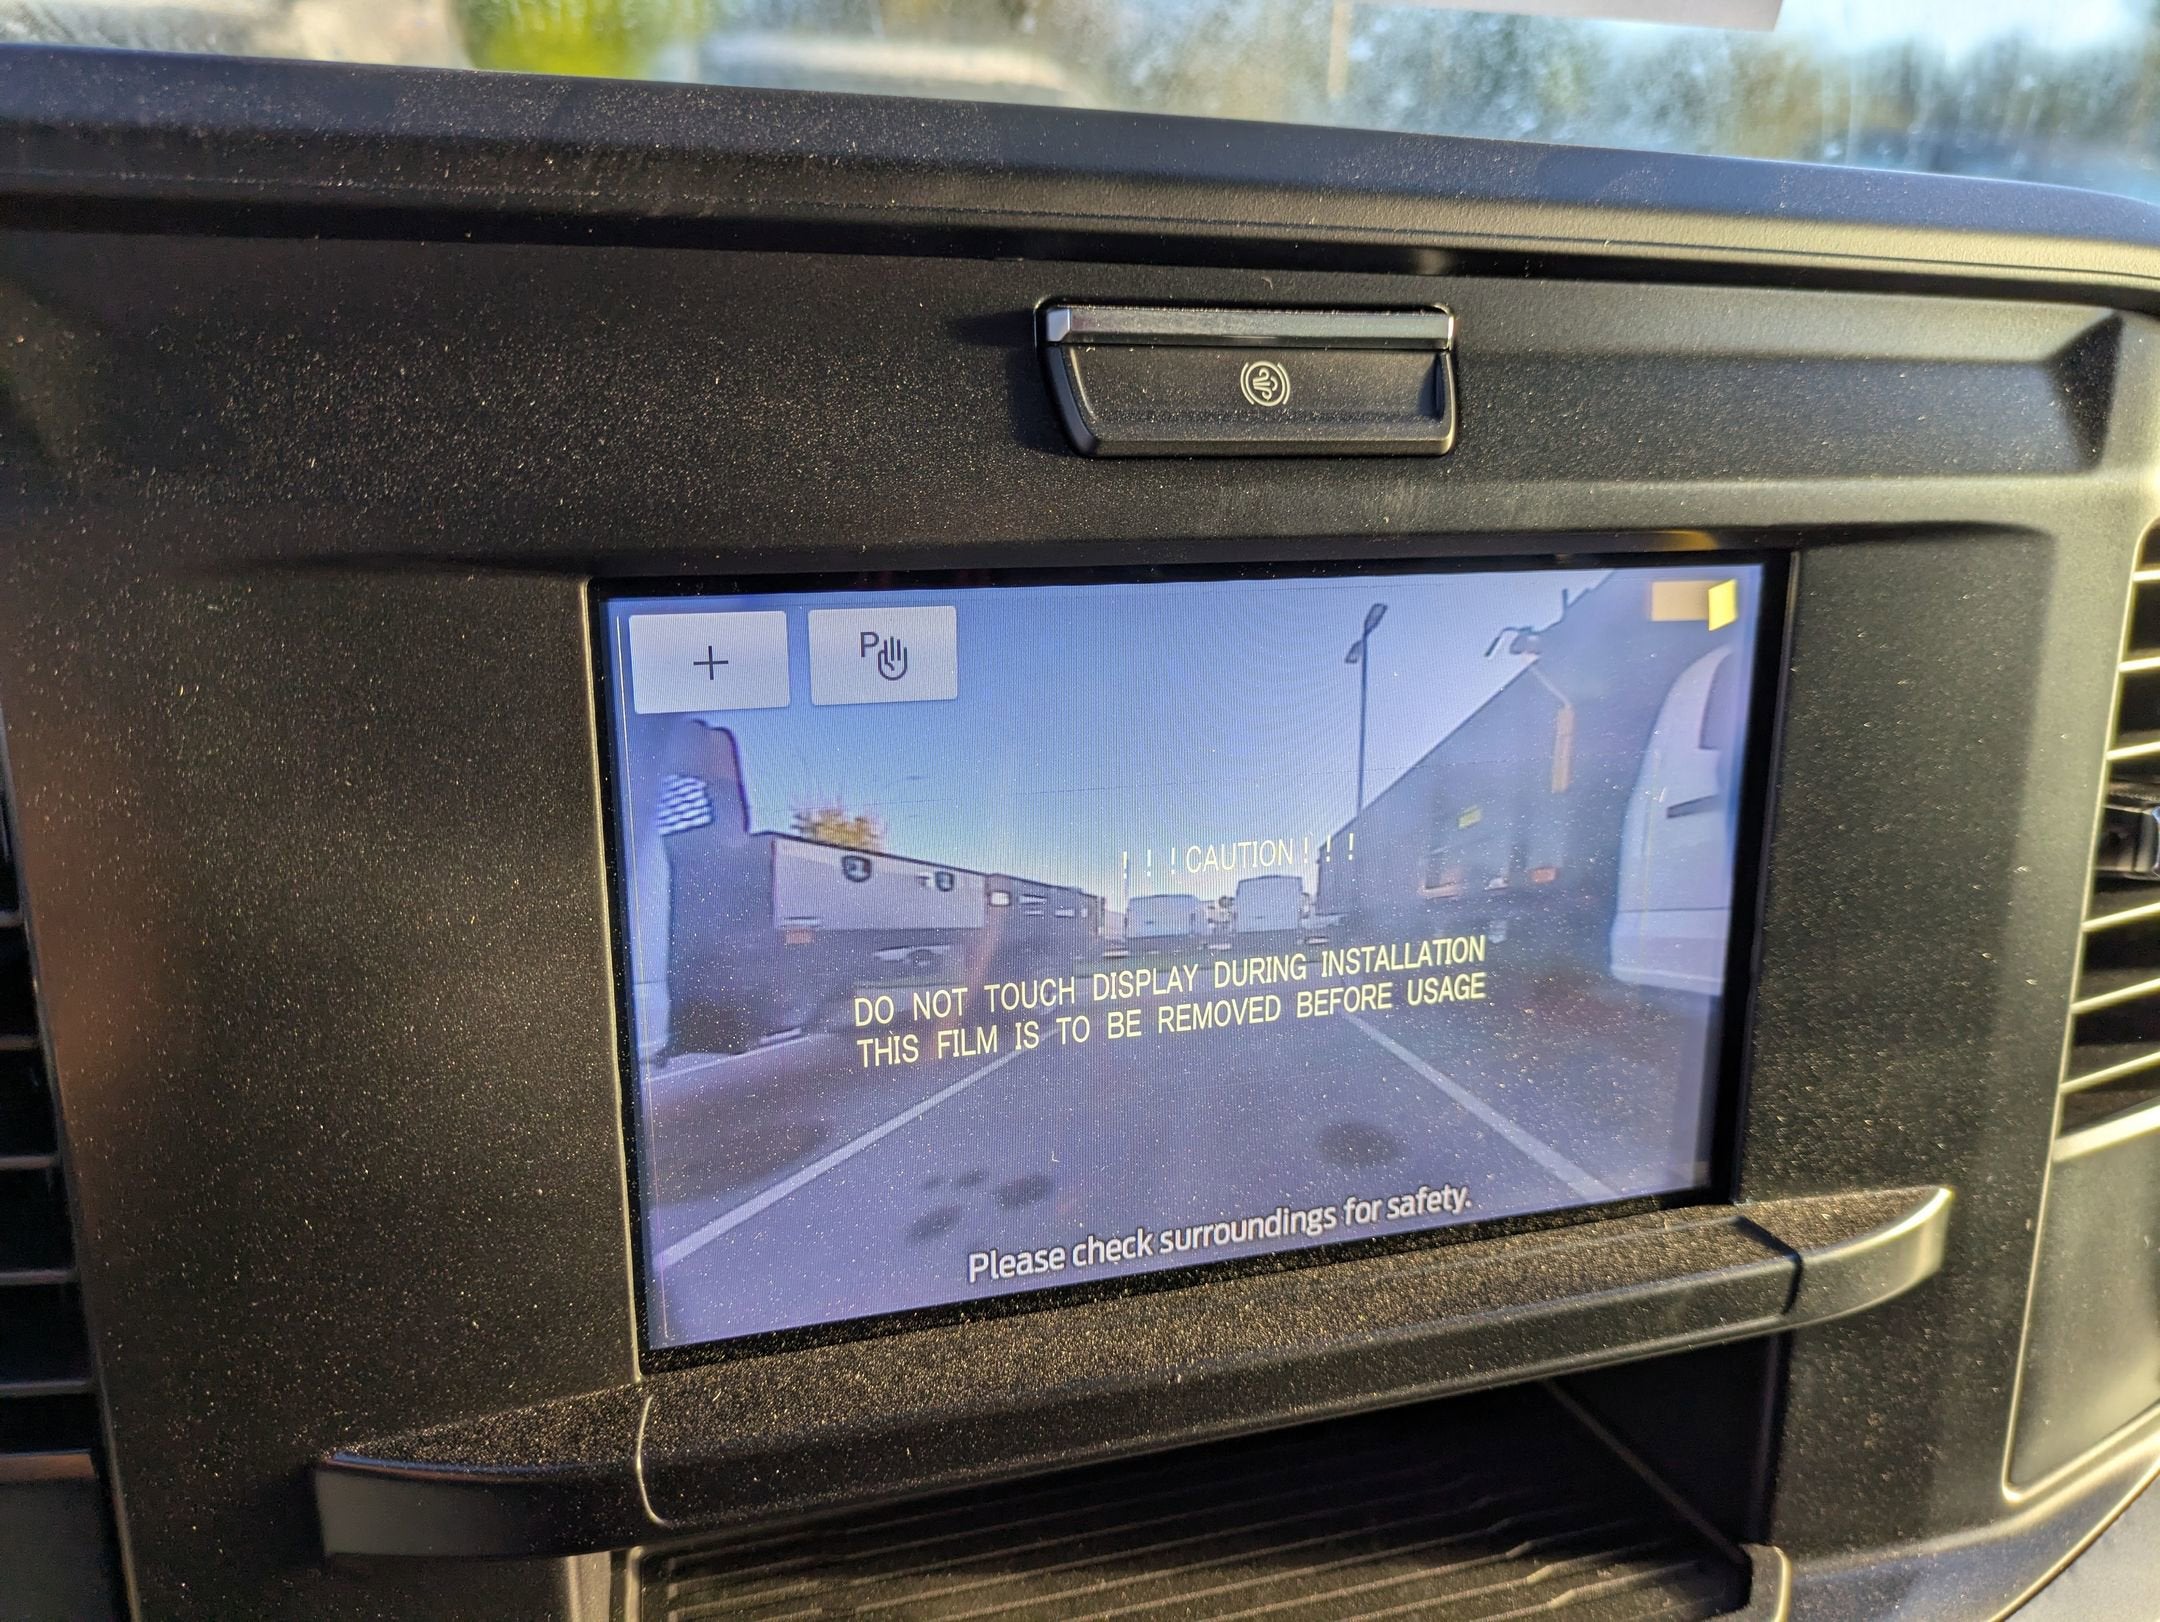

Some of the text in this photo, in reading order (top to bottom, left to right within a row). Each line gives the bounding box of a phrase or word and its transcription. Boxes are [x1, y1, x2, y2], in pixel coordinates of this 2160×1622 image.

[854, 935, 1486, 1027] DO NOT TOUCH DISPLAY DURING INSTALLATION
[857, 972, 1487, 1068] THIS FILM IS TO BE REMOVED BEFORE USAGE
[968, 1184, 1473, 1283] Please check surroundings for safety.
